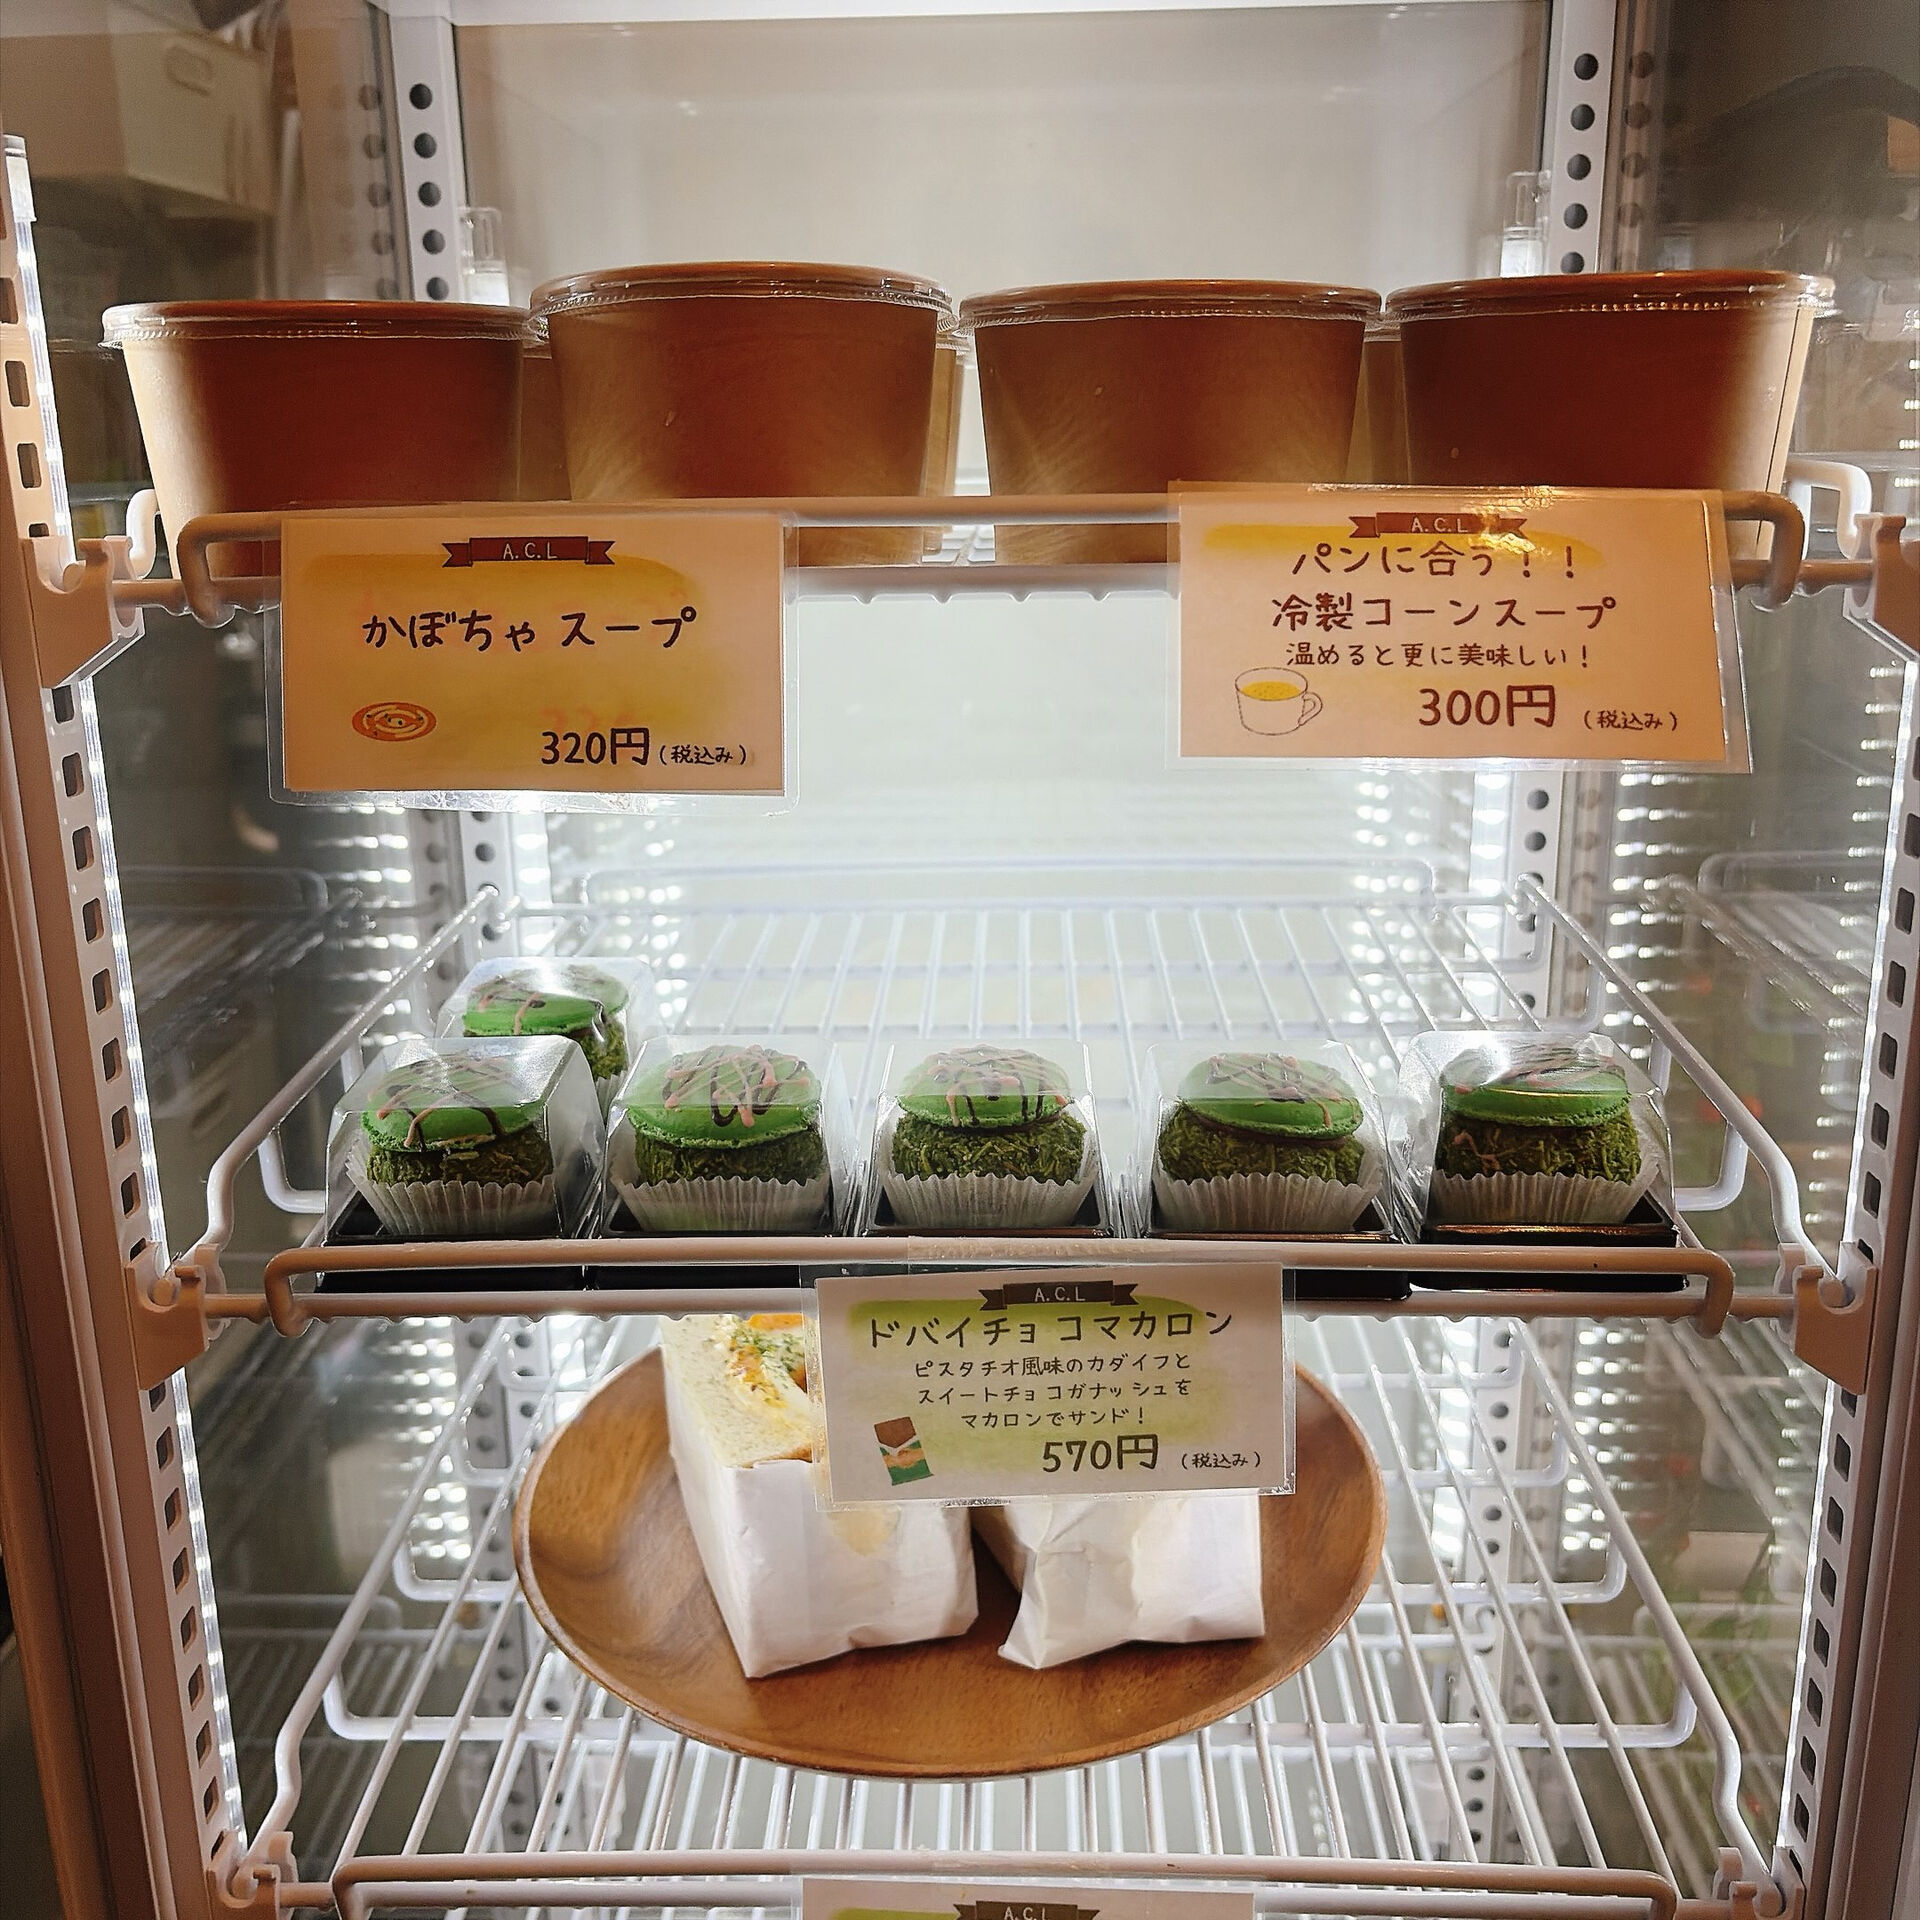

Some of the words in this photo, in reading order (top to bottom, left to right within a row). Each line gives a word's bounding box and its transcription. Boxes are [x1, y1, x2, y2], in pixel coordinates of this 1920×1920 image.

[1410, 517, 1468, 534] A.C.L
[502, 542, 558, 560] A.C.L
[1291, 541, 1575, 579] パンに合う！！
[1271, 592, 1617, 632] 冷製コーンスープ
[1283, 642, 1588, 668] 温めると更に美味しい！
[1418, 684, 1557, 728] 300円
[1034, 1286, 1086, 1303] A.C.L
[915, 1352, 1191, 1378] ピスタチオ風味のカダイフと
[917, 1378, 1192, 1405] スイートチョコガナッシュを
[960, 1406, 1144, 1429] マカロンでサンド！
[1042, 1433, 1159, 1474] 570円
